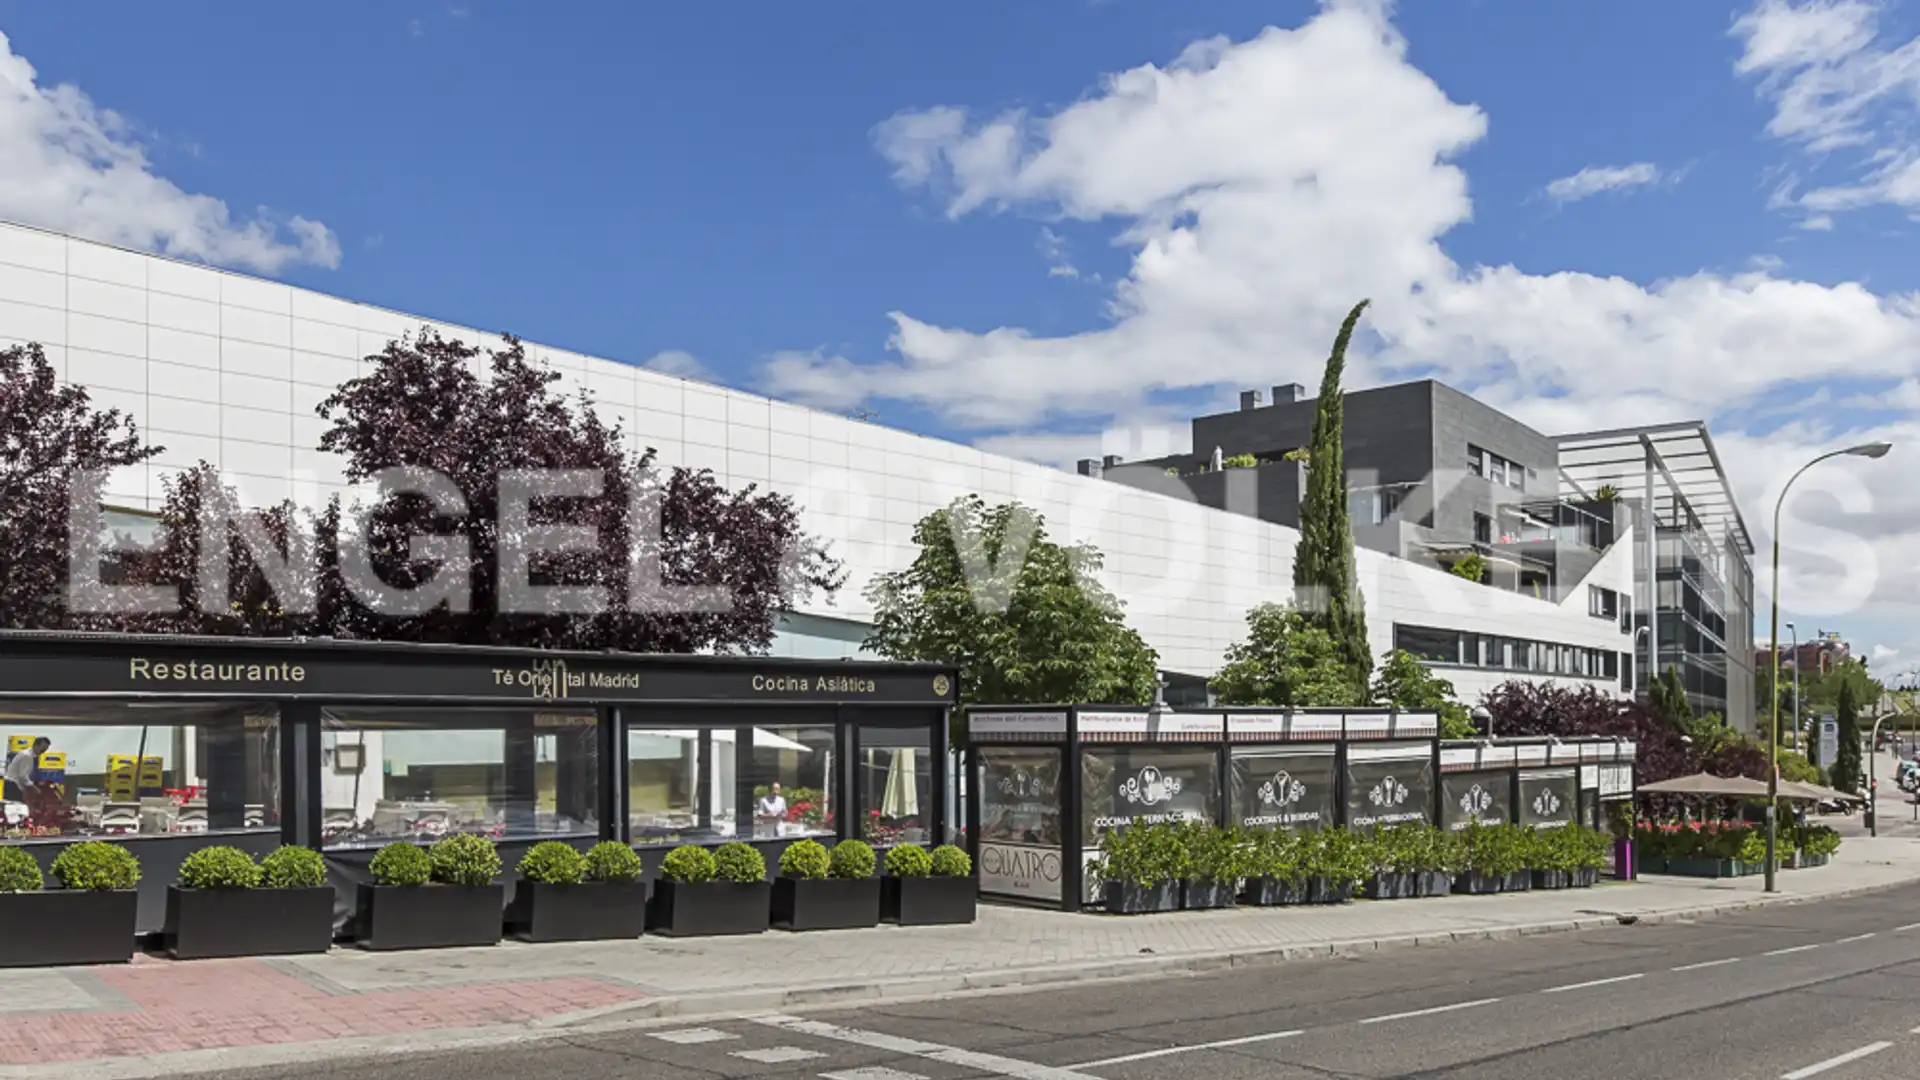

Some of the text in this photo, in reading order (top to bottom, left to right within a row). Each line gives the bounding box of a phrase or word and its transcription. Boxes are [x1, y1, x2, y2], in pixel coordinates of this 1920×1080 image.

[129, 657, 306, 683] Restaurante
[491, 669, 514, 685] Té
[589, 671, 640, 689] Madrid
[752, 674, 876, 693] Cocina Asiática
[1094, 815, 1132, 827] COCINA
